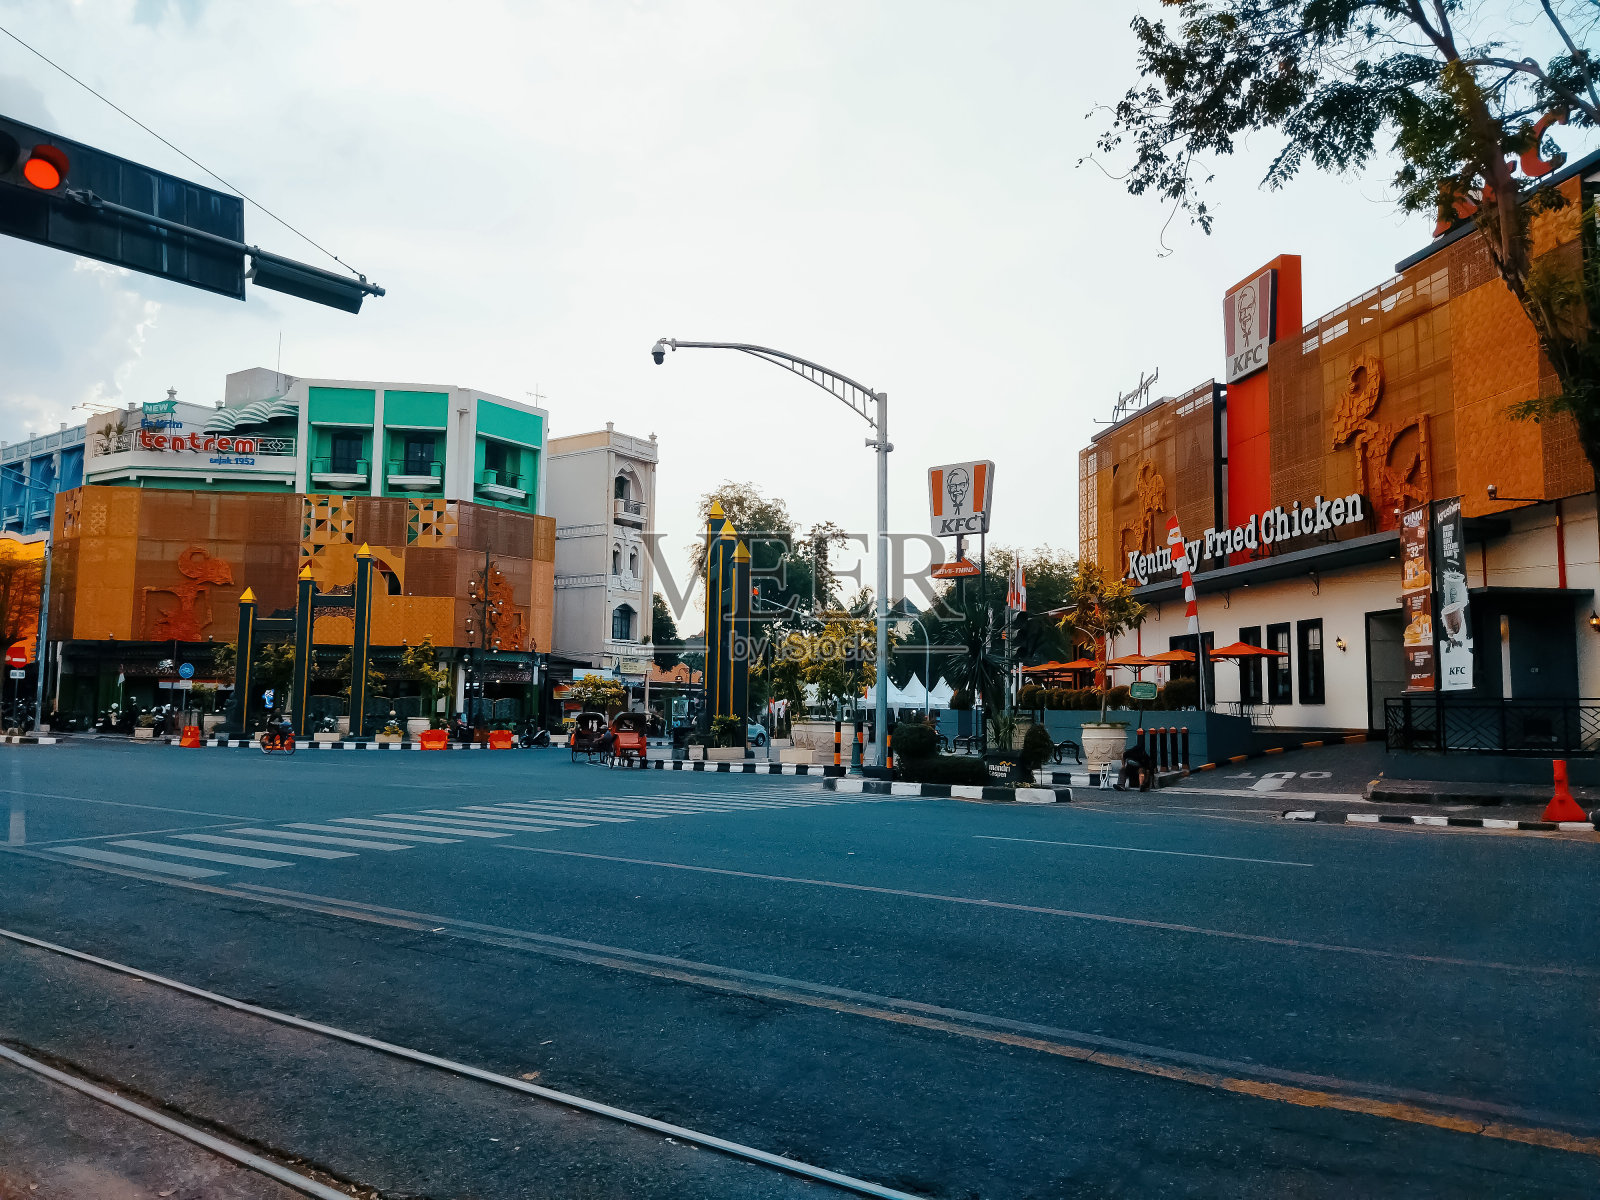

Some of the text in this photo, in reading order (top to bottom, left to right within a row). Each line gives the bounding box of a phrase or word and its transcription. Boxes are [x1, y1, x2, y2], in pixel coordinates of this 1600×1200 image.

[1232, 344, 1263, 376] KFC
[145, 403, 168, 412] NEW
[139, 430, 256, 453] tentrem
[940, 515, 976, 534] KFC
[1128, 493, 1364, 585] Kentuky Fried Chicken
[1449, 666, 1466, 675] KFC
[989, 764, 1011, 772] mandiri
